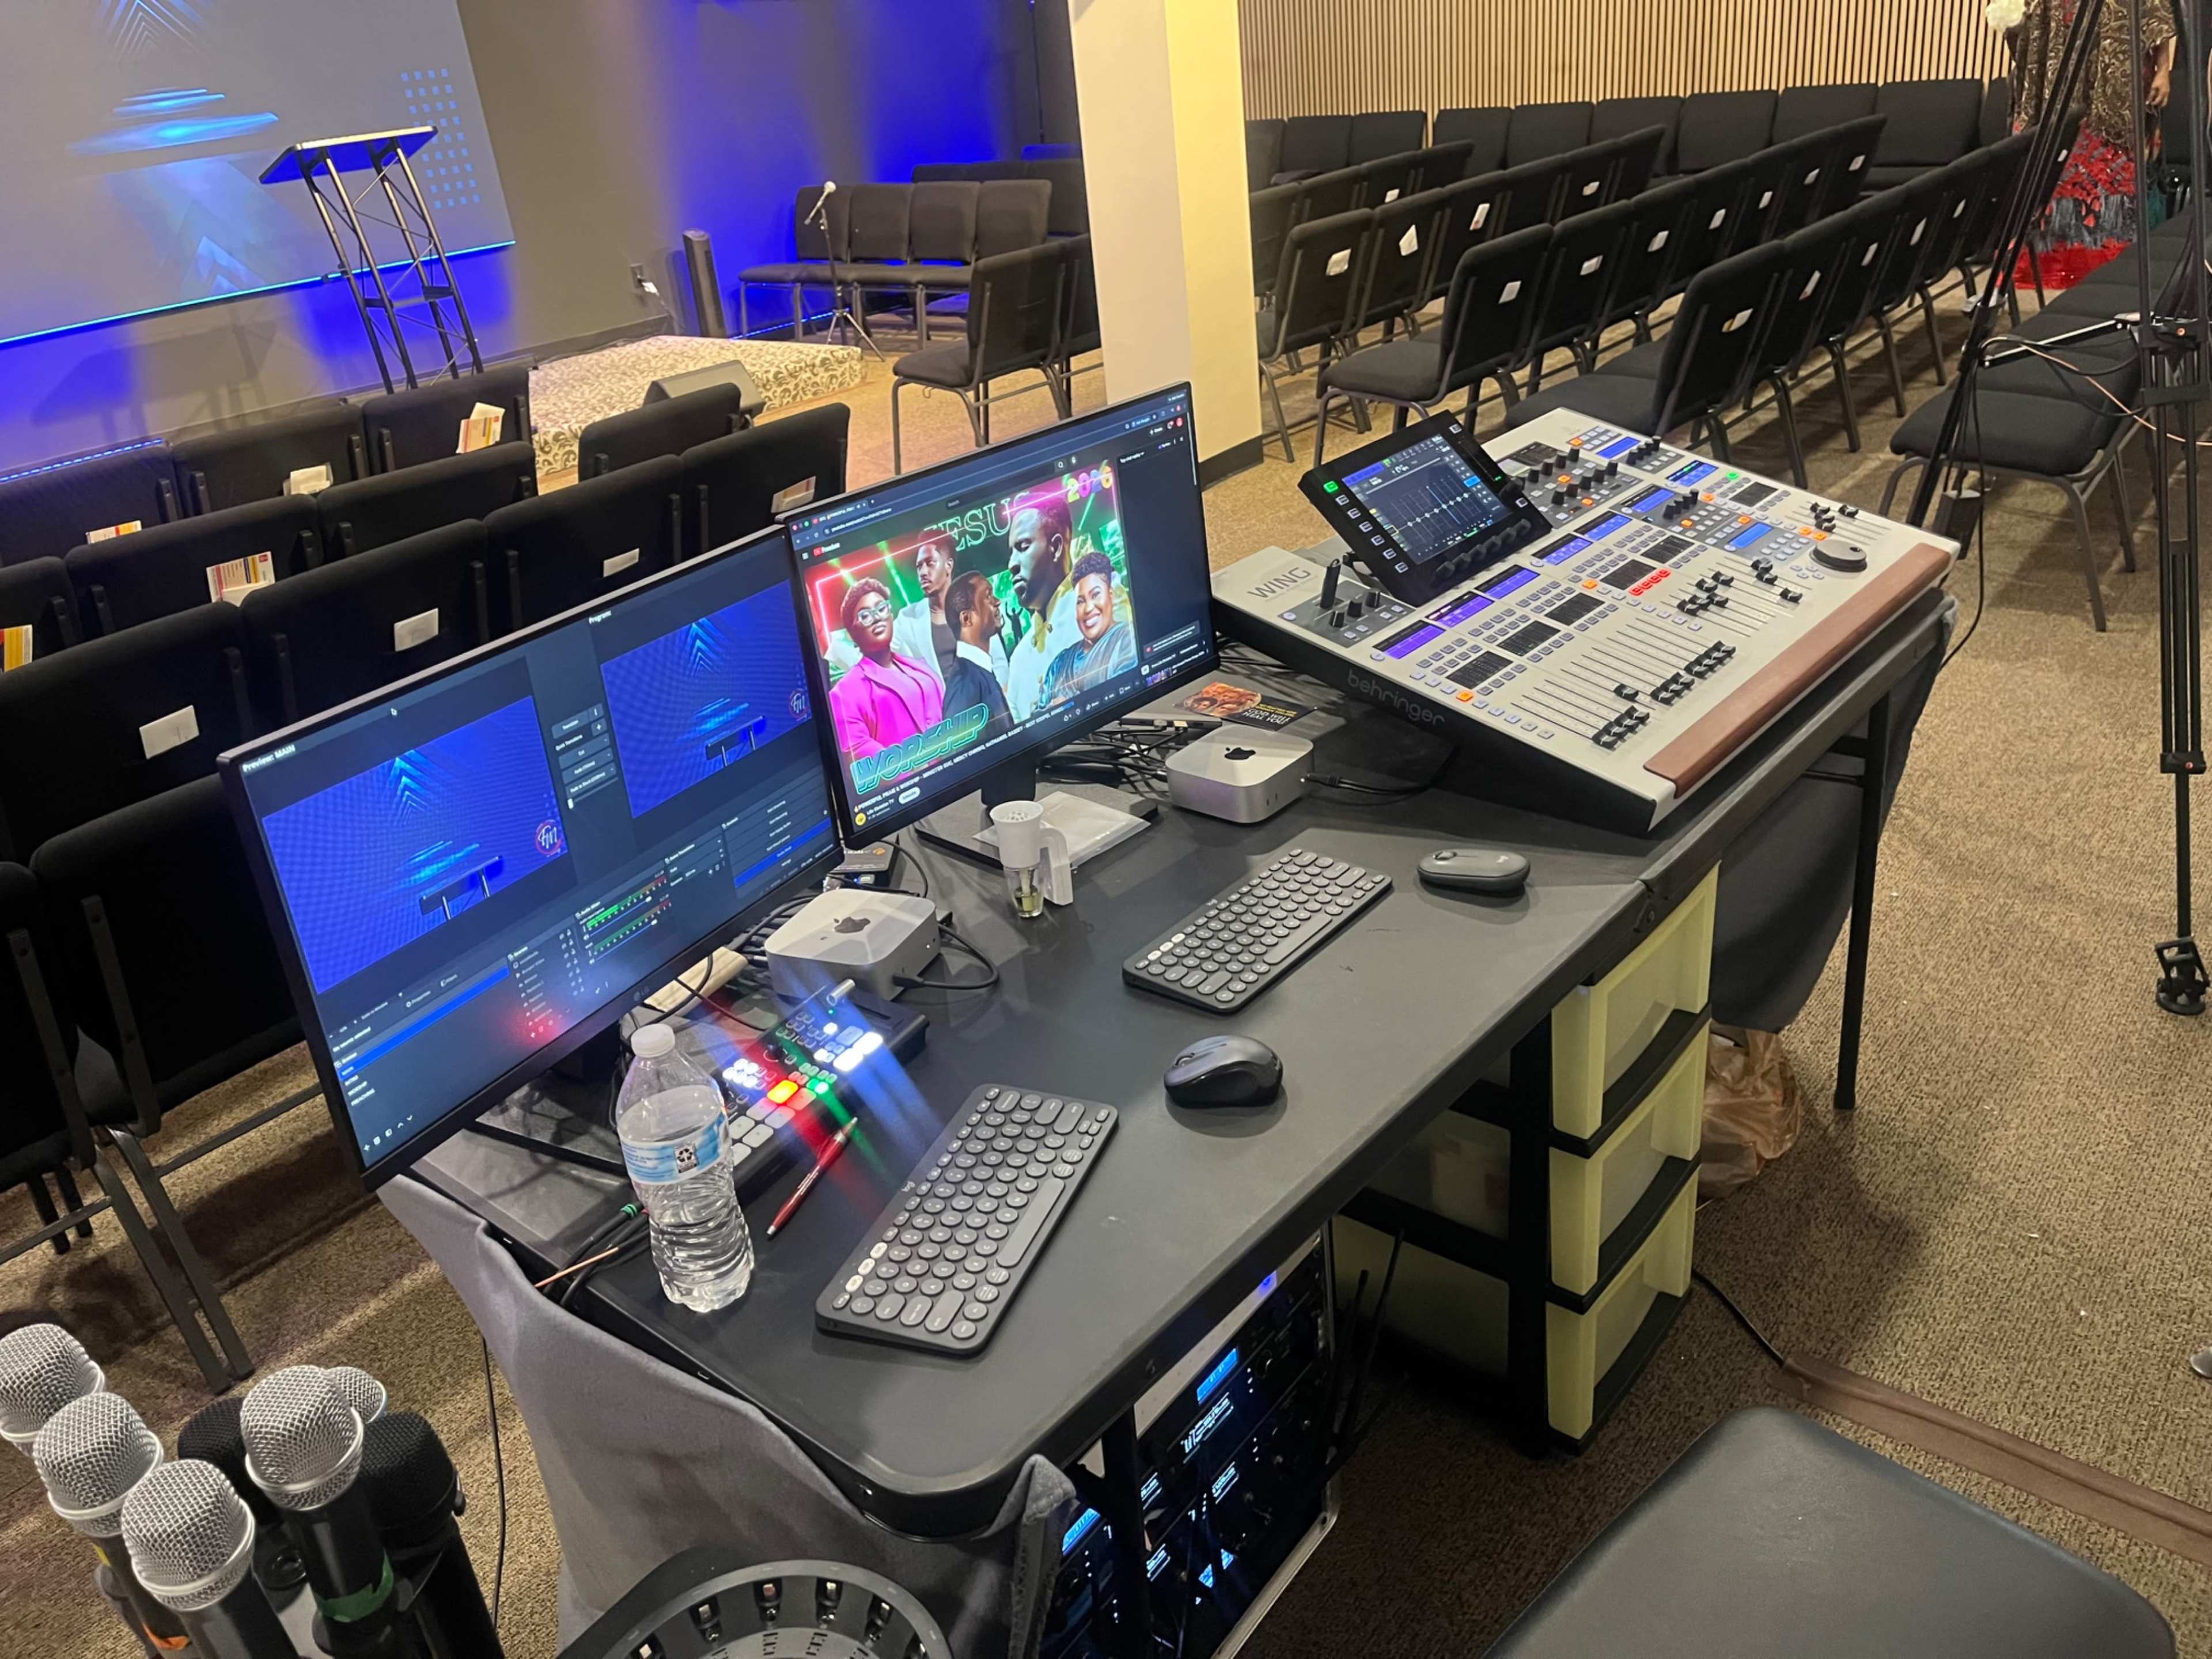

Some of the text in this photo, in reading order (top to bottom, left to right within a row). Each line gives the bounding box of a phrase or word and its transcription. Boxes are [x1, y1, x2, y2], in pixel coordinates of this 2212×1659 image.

[924, 491, 1029, 552] ESU
[1247, 567, 1311, 598] WING
[1347, 668, 1446, 726] behringer
[1248, 709, 1270, 717] GOD
[1266, 717, 1287, 725] YOU
[243, 744, 296, 772] Preview: MAIN
[850, 702, 990, 795] WORSHIP
